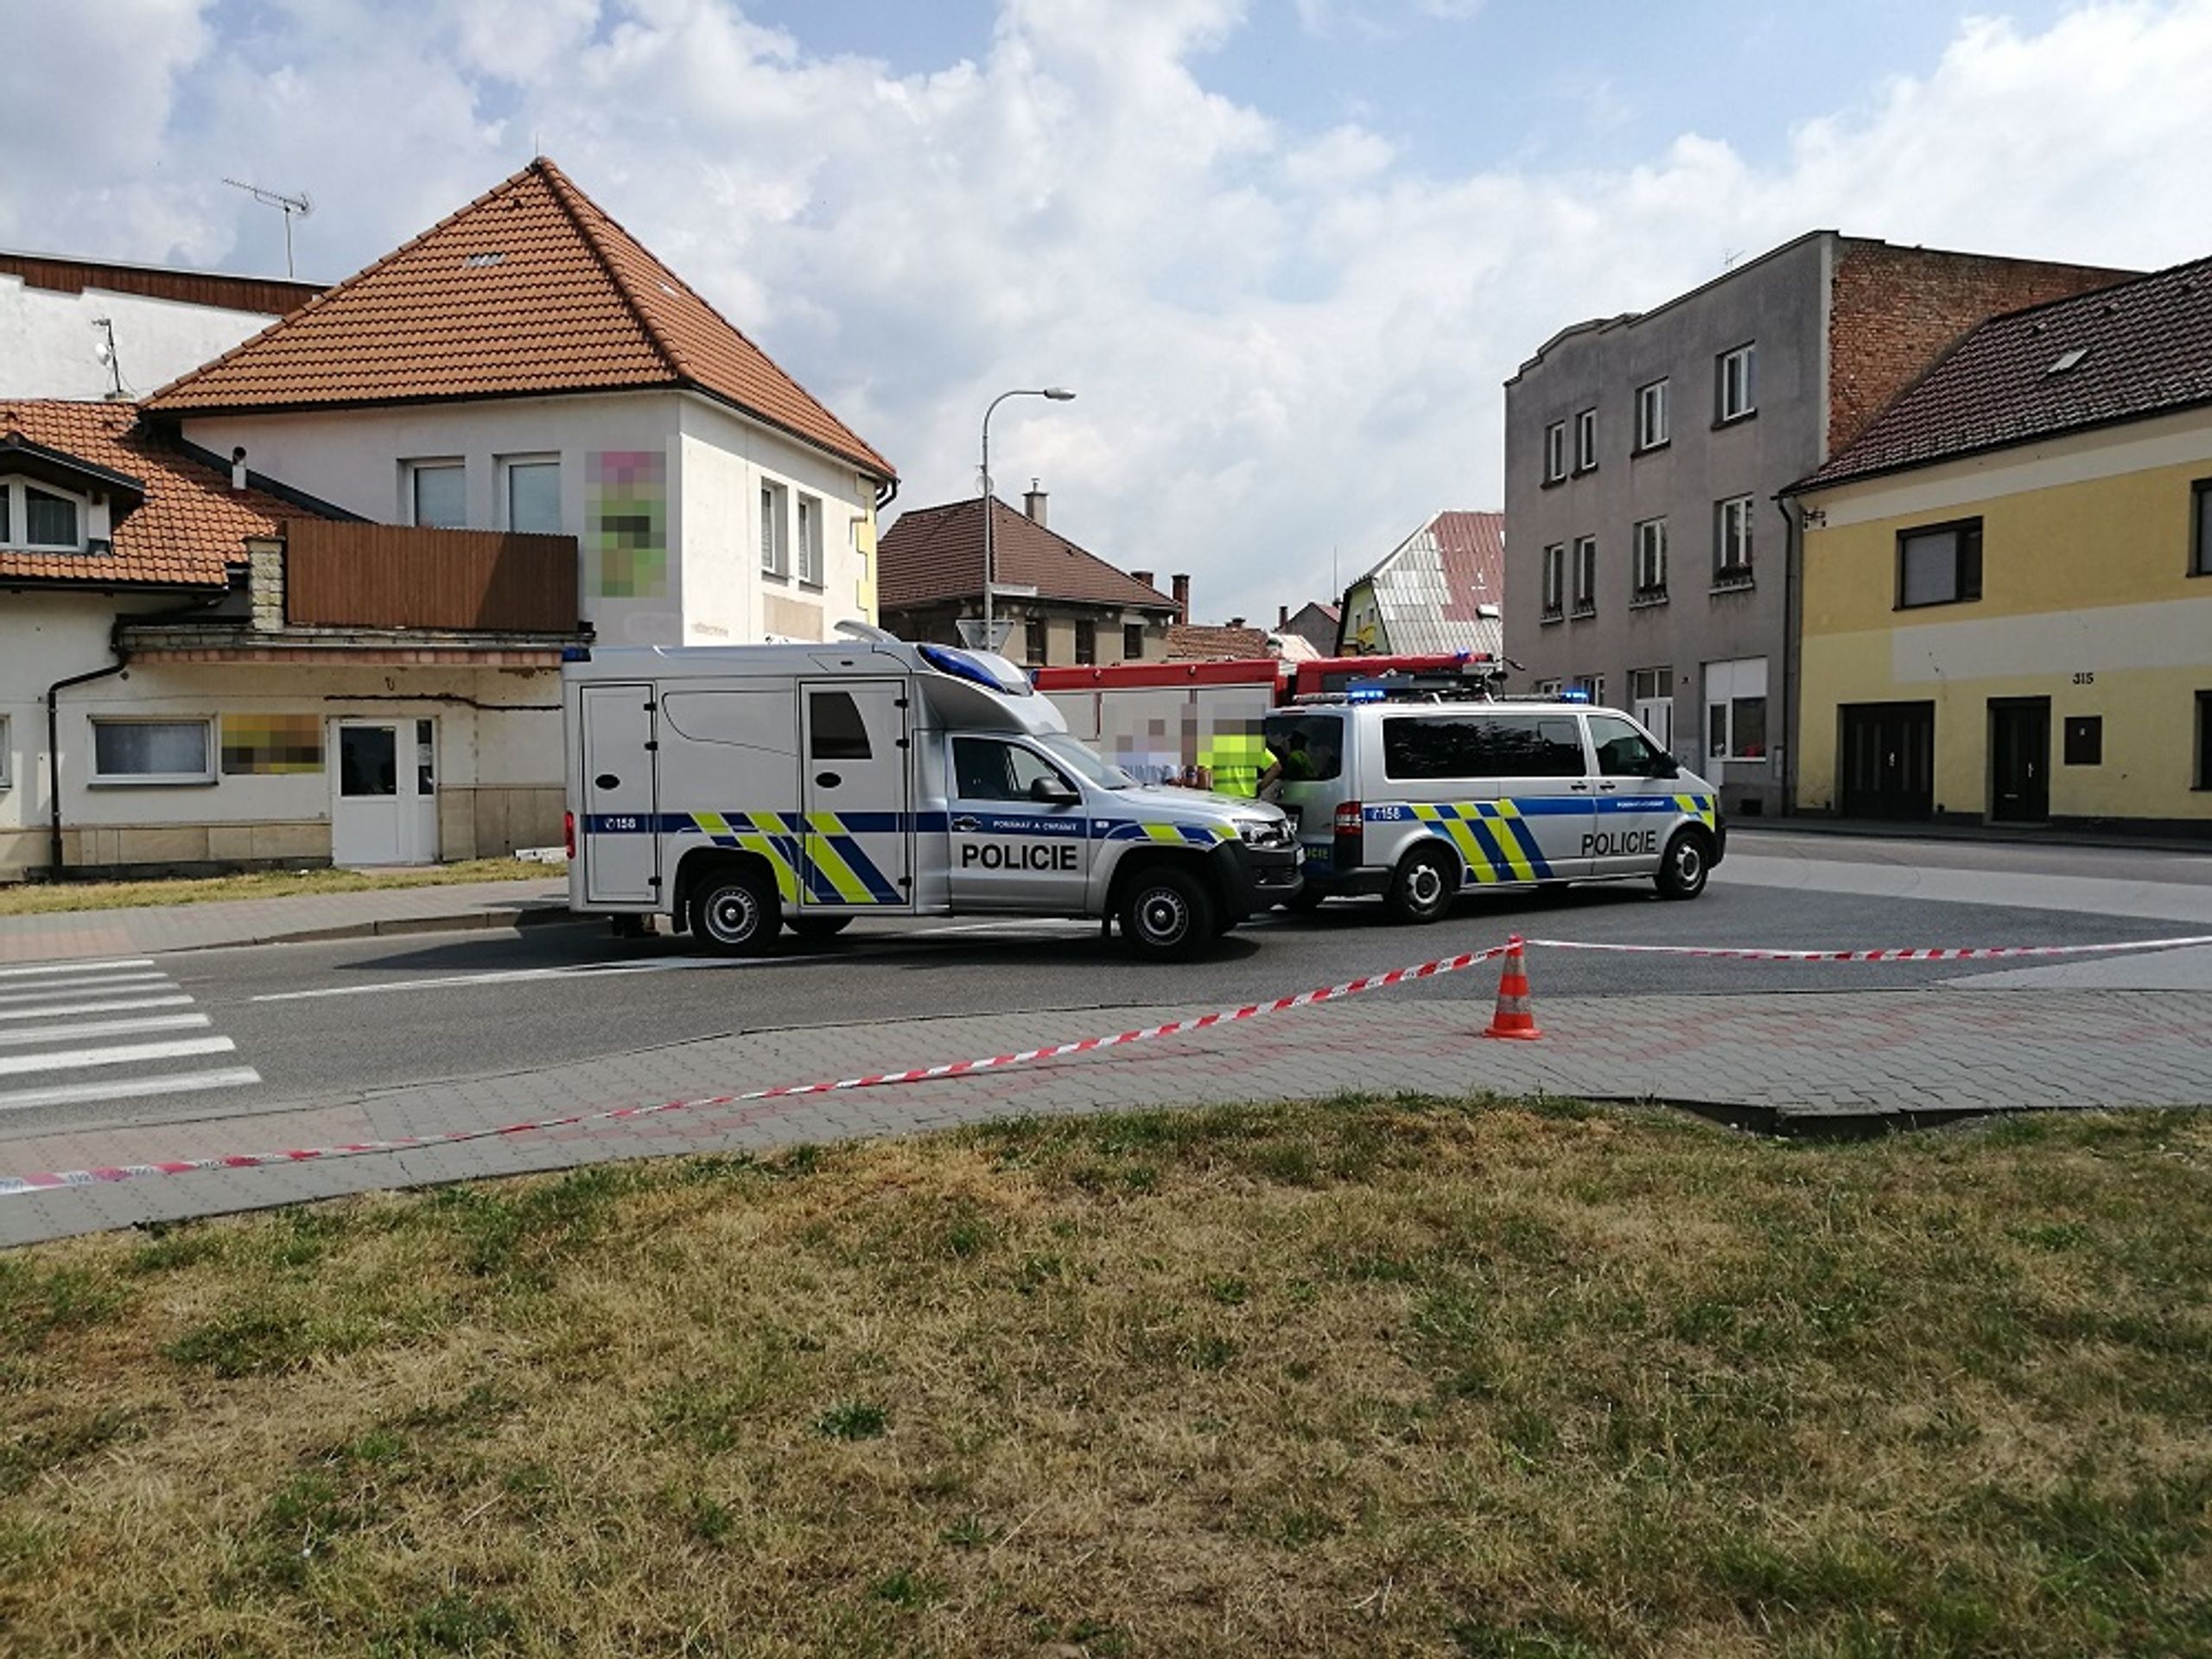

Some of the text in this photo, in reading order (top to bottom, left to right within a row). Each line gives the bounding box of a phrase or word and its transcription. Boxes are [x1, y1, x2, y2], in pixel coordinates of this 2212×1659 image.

[1382, 807, 1402, 819] 158
[616, 817, 636, 830] 158
[1580, 830, 1656, 856] POLICIE
[962, 843, 1077, 870] POLICIE
